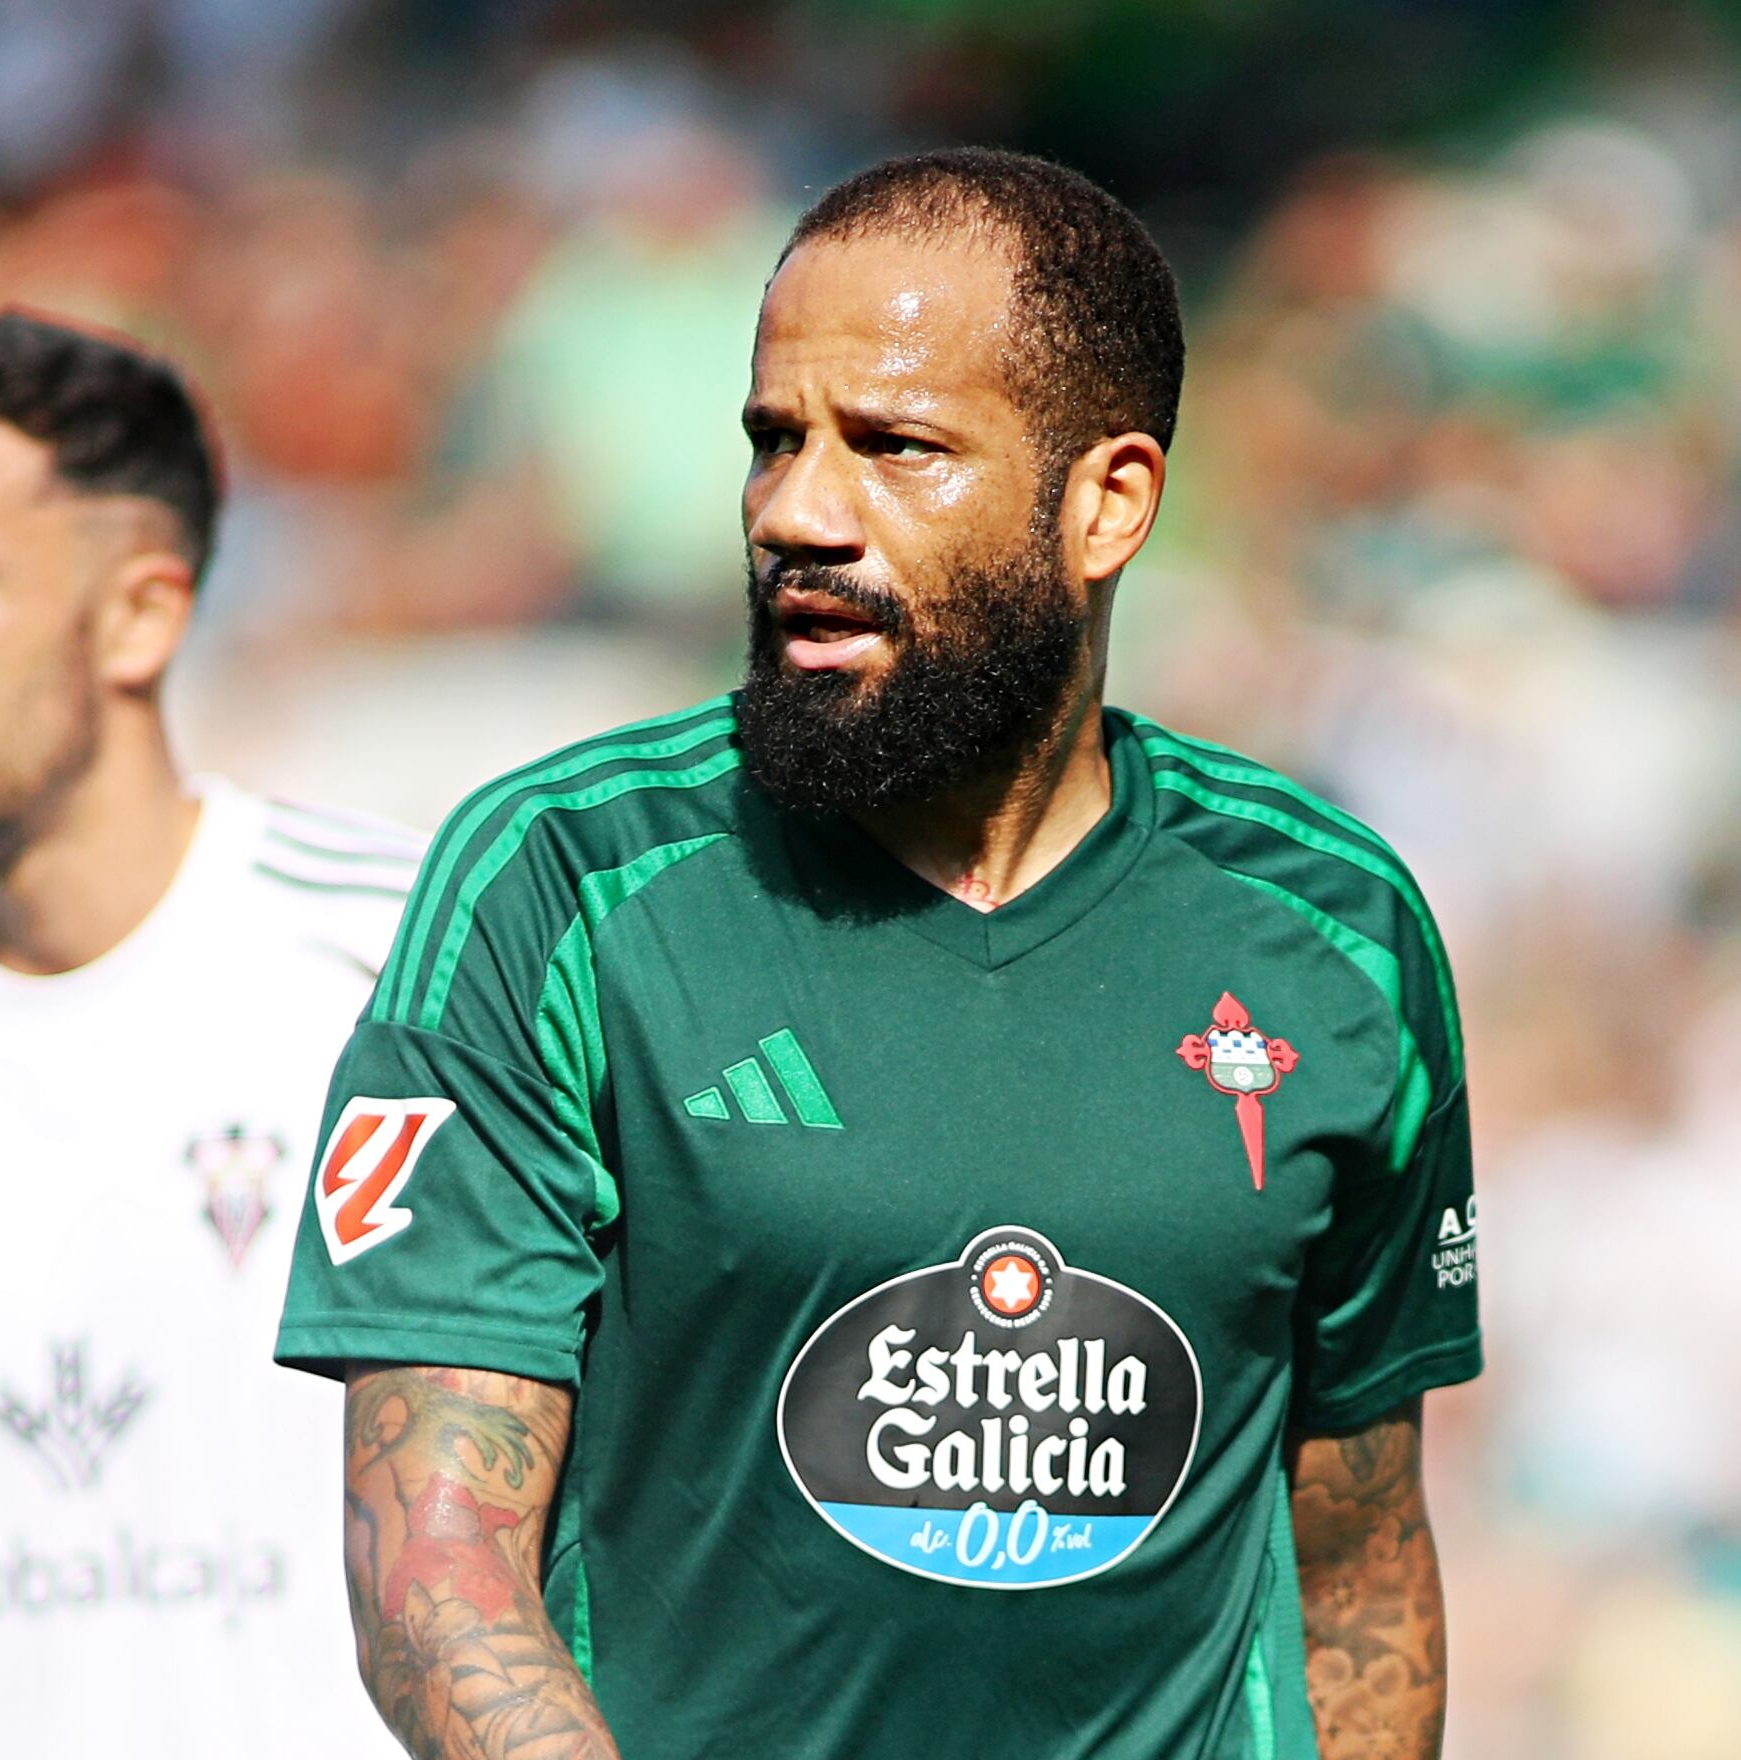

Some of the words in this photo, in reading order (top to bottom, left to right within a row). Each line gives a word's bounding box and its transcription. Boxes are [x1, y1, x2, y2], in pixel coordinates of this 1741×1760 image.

[1439, 1207, 1462, 1239] A
[858, 1324, 1147, 1415] Estrella
[866, 1407, 1126, 1498] Galicia
[956, 1499, 1049, 1570] 0,0
